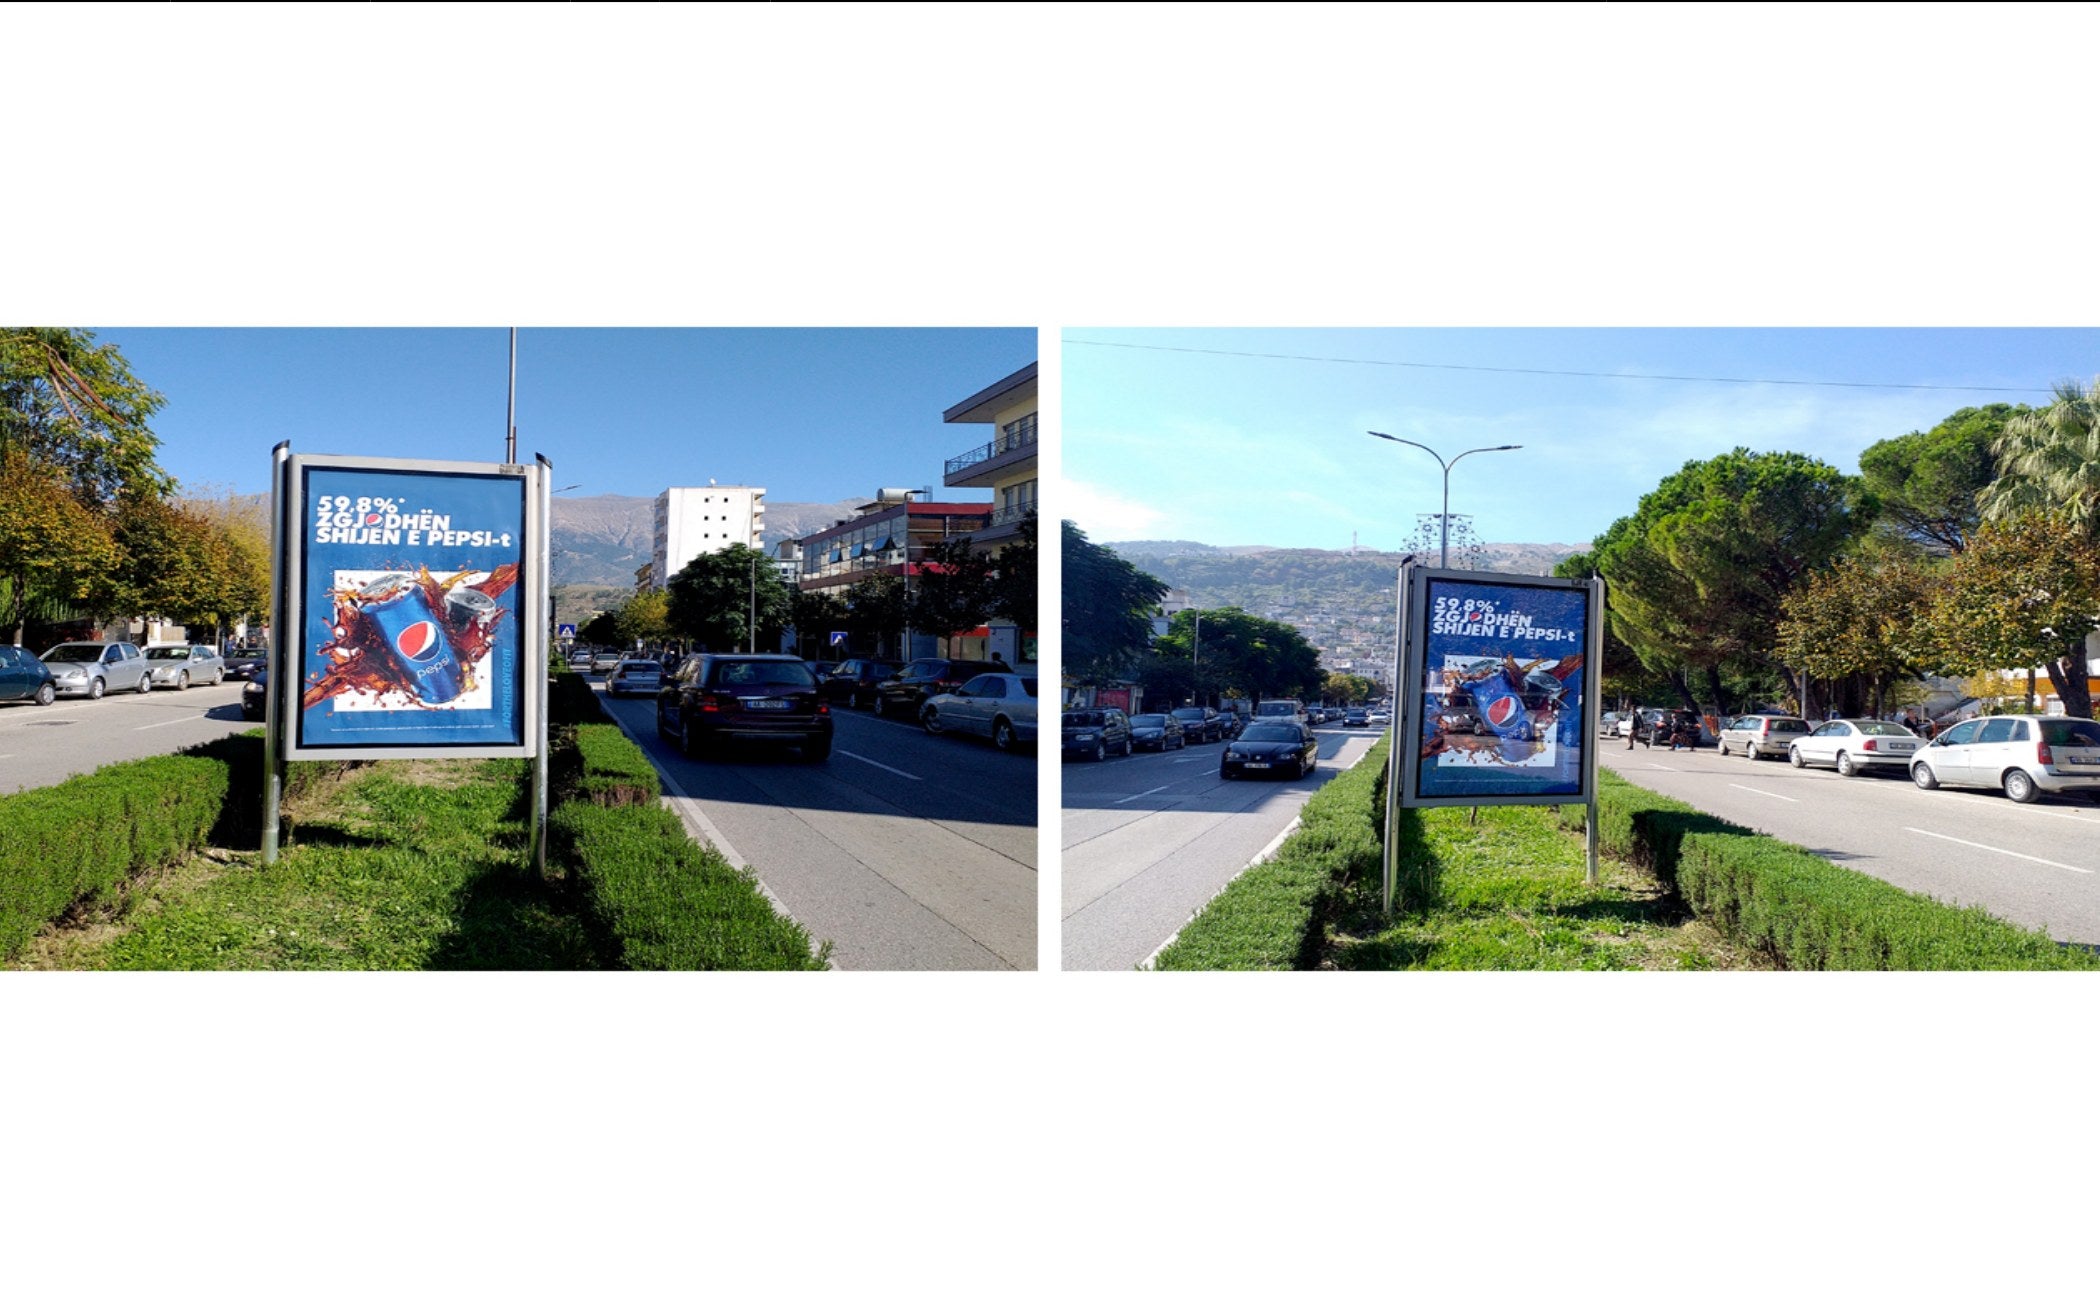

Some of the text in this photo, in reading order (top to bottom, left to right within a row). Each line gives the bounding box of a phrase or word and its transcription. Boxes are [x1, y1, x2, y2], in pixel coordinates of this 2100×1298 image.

[315, 528, 511, 548] SHIJEN E PEPSI-t
[1432, 623, 1576, 641] SHIJEN E PEPSI-t
[416, 654, 450, 680] pepsi
